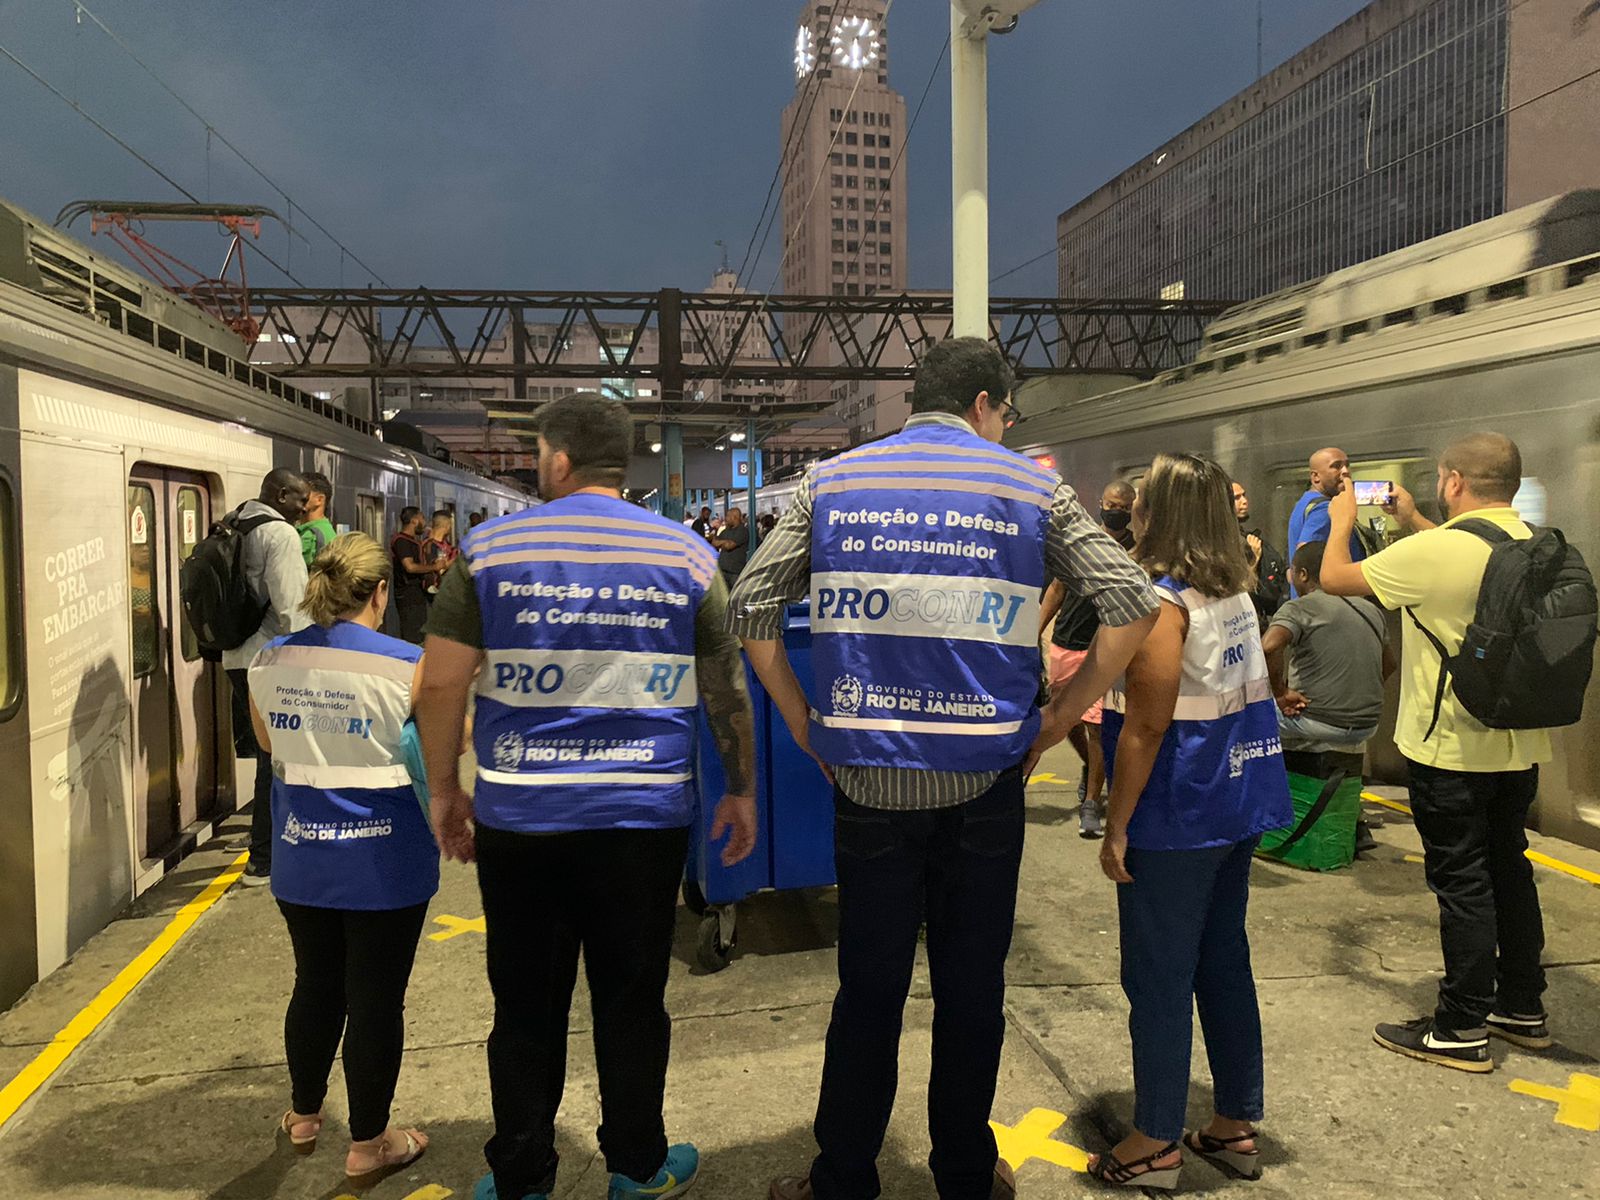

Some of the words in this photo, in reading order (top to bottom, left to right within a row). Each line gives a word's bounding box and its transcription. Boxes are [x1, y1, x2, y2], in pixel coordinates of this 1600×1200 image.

[828, 508, 919, 527] Proteção
[924, 513, 938, 526] e
[945, 510, 1019, 536] Defesa
[841, 536, 866, 552] do
[871, 535, 997, 560] Consumidor
[45, 536, 105, 582] CORRER
[57, 572, 88, 606] PRA
[498, 581, 594, 601] Proteção
[598, 586, 613, 599] e
[618, 584, 689, 606] Defesa
[516, 608, 541, 624] do
[546, 608, 670, 629] Consumidor
[817, 587, 1026, 636] PROCONRJ
[276, 686, 314, 697] Proteção
[324, 690, 356, 700] Defesa
[281, 697, 293, 705] do
[294, 699, 349, 711] Consumidor
[867, 684, 922, 697] GOVERNO
[928, 691, 944, 699] DO
[950, 693, 995, 702] ESTADO
[866, 694, 897, 709] RIO
[899, 698, 921, 711] DE
[924, 700, 997, 717] JANEIRO
[525, 748, 557, 761] RIO
[558, 748, 582, 761] DE
[583, 747, 654, 762] JANEIRO
[301, 822, 337, 830] OVERNO
[318, 829, 336, 840] DE
[337, 825, 392, 840] JANEIRO
